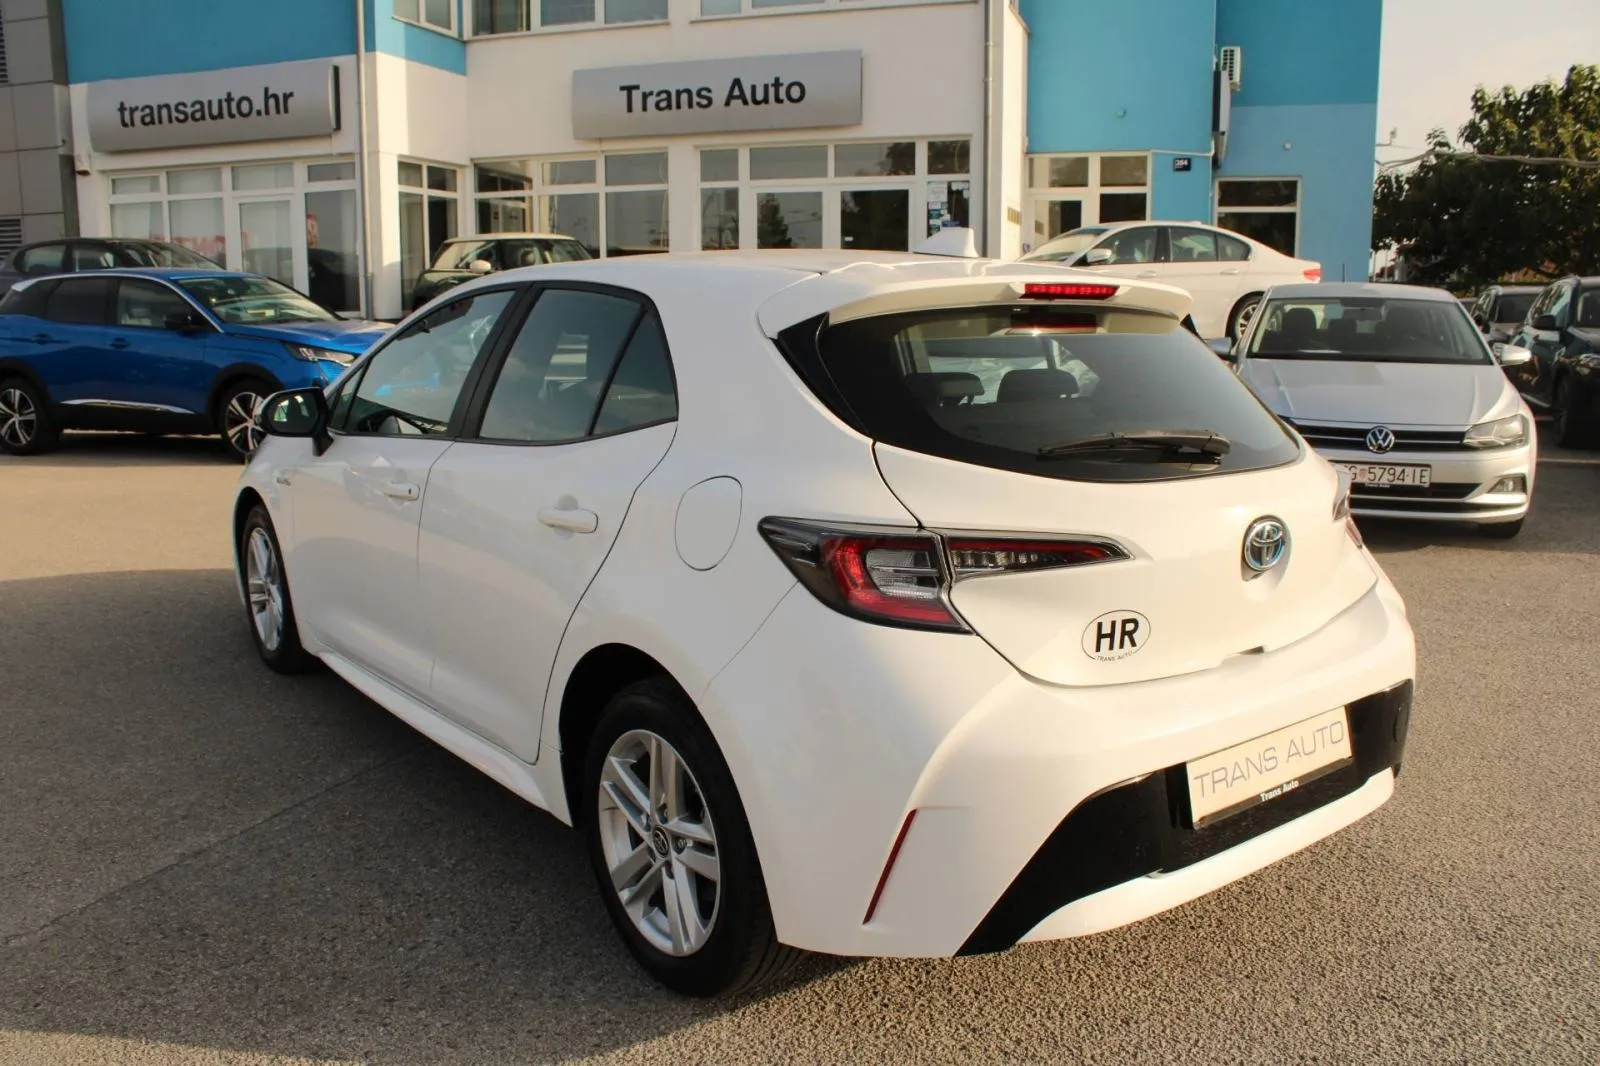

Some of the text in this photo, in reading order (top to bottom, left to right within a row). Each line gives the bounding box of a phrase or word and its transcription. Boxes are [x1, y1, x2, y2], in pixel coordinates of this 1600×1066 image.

[117, 86, 294, 128] transauto.hr
[619, 76, 806, 113] Trans Auto
[1095, 618, 1139, 652] HR
[1194, 720, 1344, 798] TRANS AUTO
[1260, 780, 1299, 802] Trans Auto
